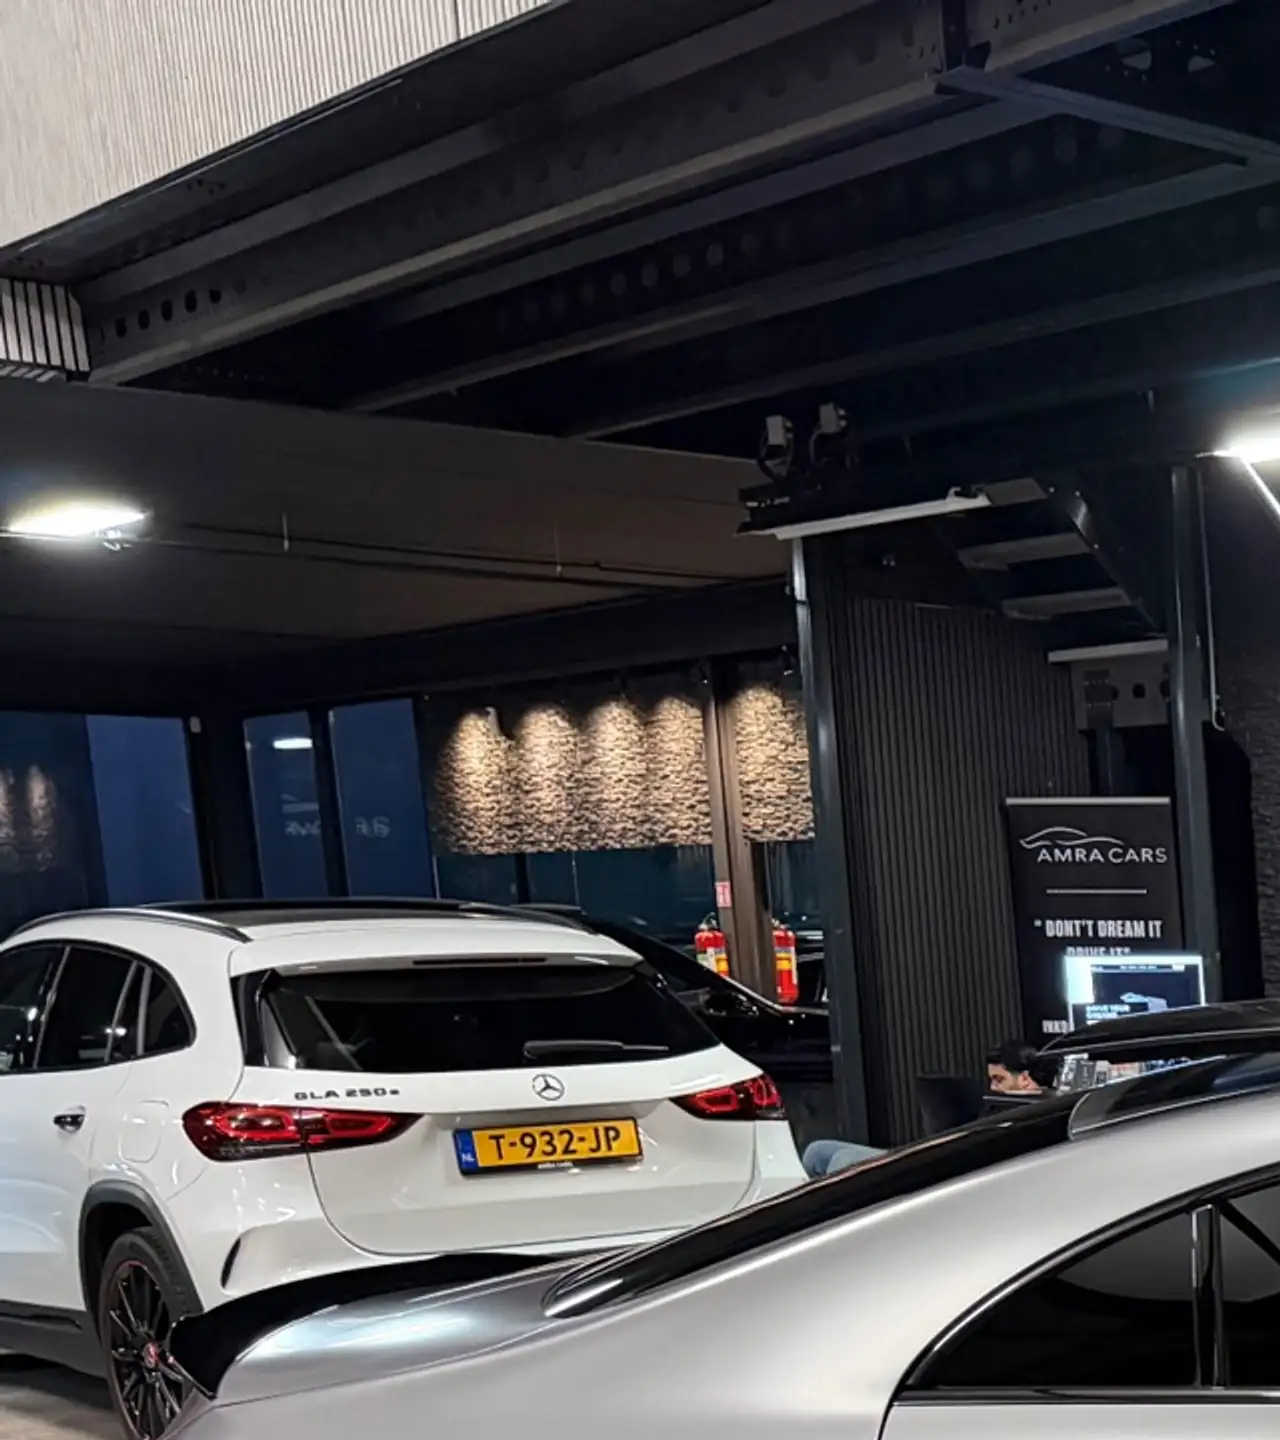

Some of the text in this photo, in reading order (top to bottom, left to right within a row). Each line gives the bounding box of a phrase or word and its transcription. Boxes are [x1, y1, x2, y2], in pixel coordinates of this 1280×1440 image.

[1036, 847, 1168, 864] AMRA CARS
[1097, 919, 1146, 938] DREAM
[1148, 920, 1163, 939] IT
[294, 1089, 340, 1101] GLA
[488, 1126, 621, 1161] T-932-JP
[462, 1153, 476, 1163] NL
